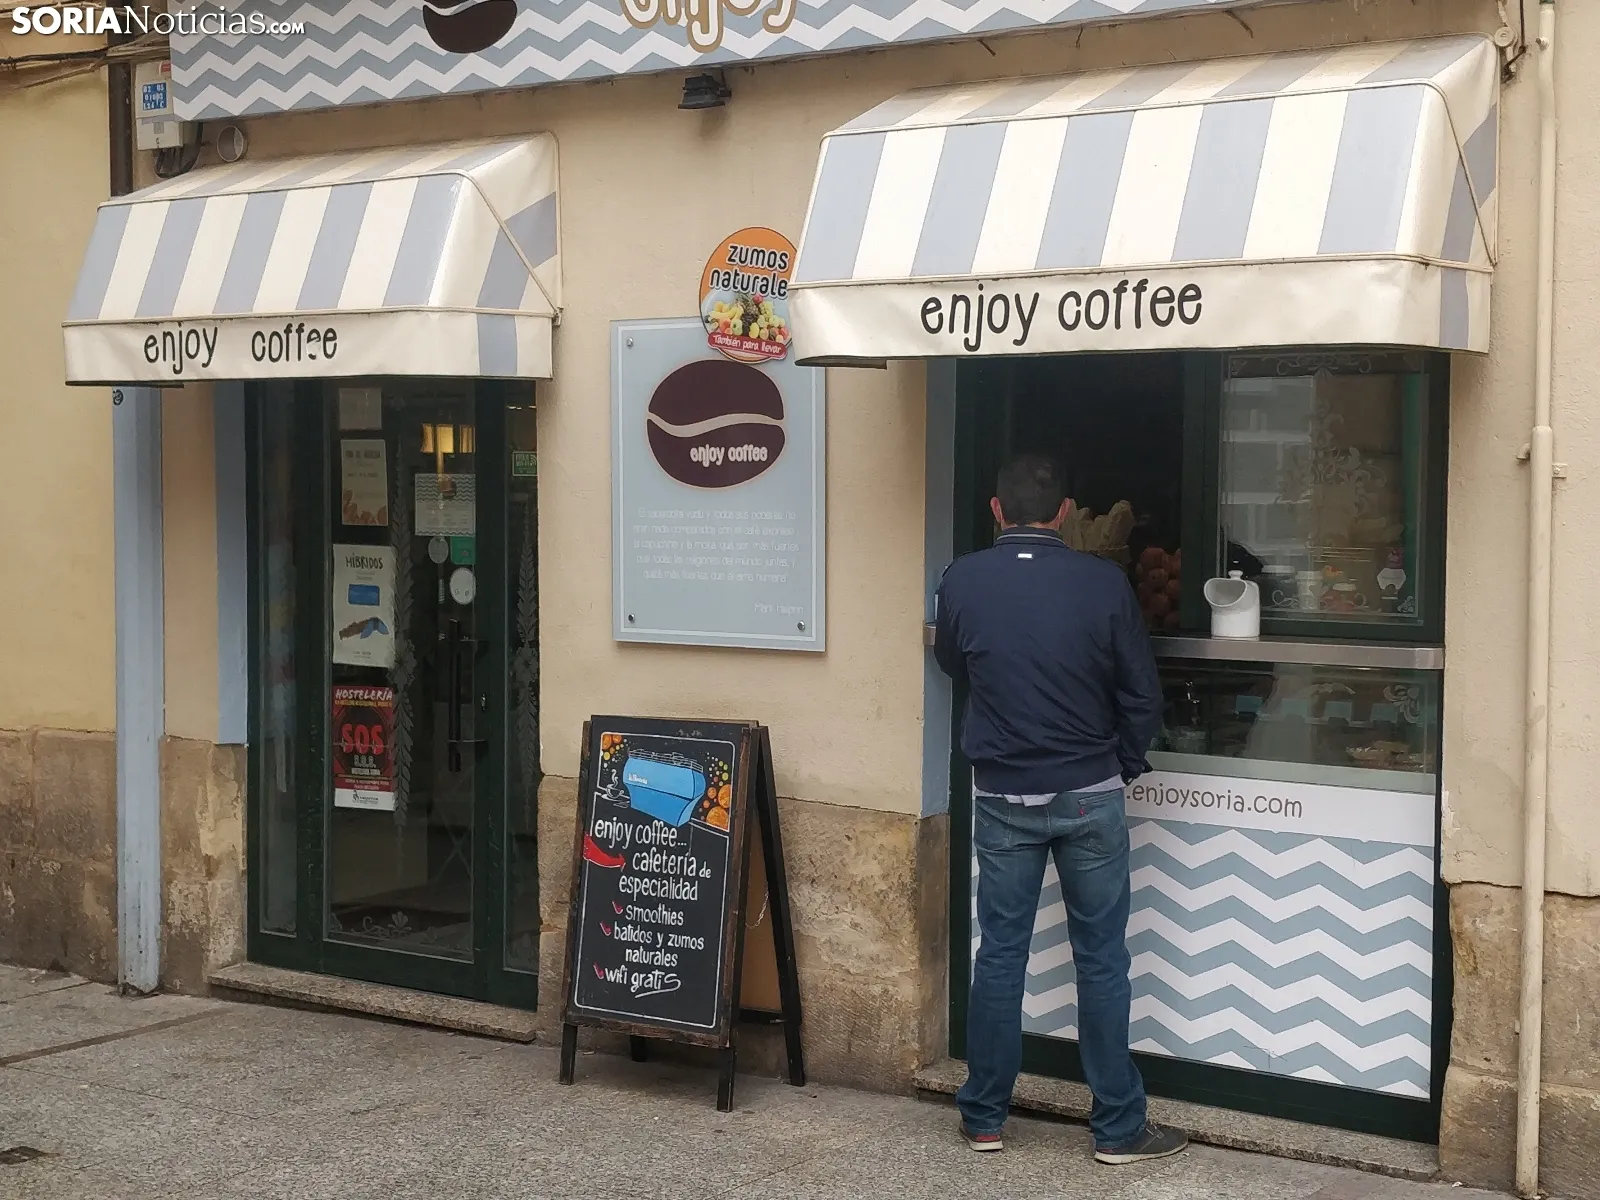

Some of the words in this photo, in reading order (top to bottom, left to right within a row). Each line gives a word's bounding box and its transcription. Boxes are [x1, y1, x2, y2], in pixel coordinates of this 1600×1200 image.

[727, 244, 789, 271] zumos
[709, 267, 789, 298] naturale
[920, 283, 1040, 352] enjoy
[1058, 278, 1202, 331] coffee
[143, 321, 218, 375] enjoy
[251, 322, 338, 363] coffee
[742, 340, 759, 351] para
[761, 342, 782, 354] llevar
[689, 443, 725, 467] enjoy
[727, 443, 768, 462] coffee
[335, 686, 393, 701] HOSTELERÍA
[341, 722, 384, 755] SOS
[1126, 783, 1303, 818] .enjoysoria.com
[594, 816, 633, 849] enjoy
[632, 846, 697, 877] cafetería
[699, 861, 712, 879] de
[618, 874, 698, 901] especialidad
[625, 903, 684, 926] smoothies
[614, 921, 653, 944] batidos
[656, 931, 663, 948] y
[667, 933, 705, 950] zumos
[625, 946, 679, 967] naturales
[604, 964, 628, 984] wifi
[631, 969, 682, 998] gratis
